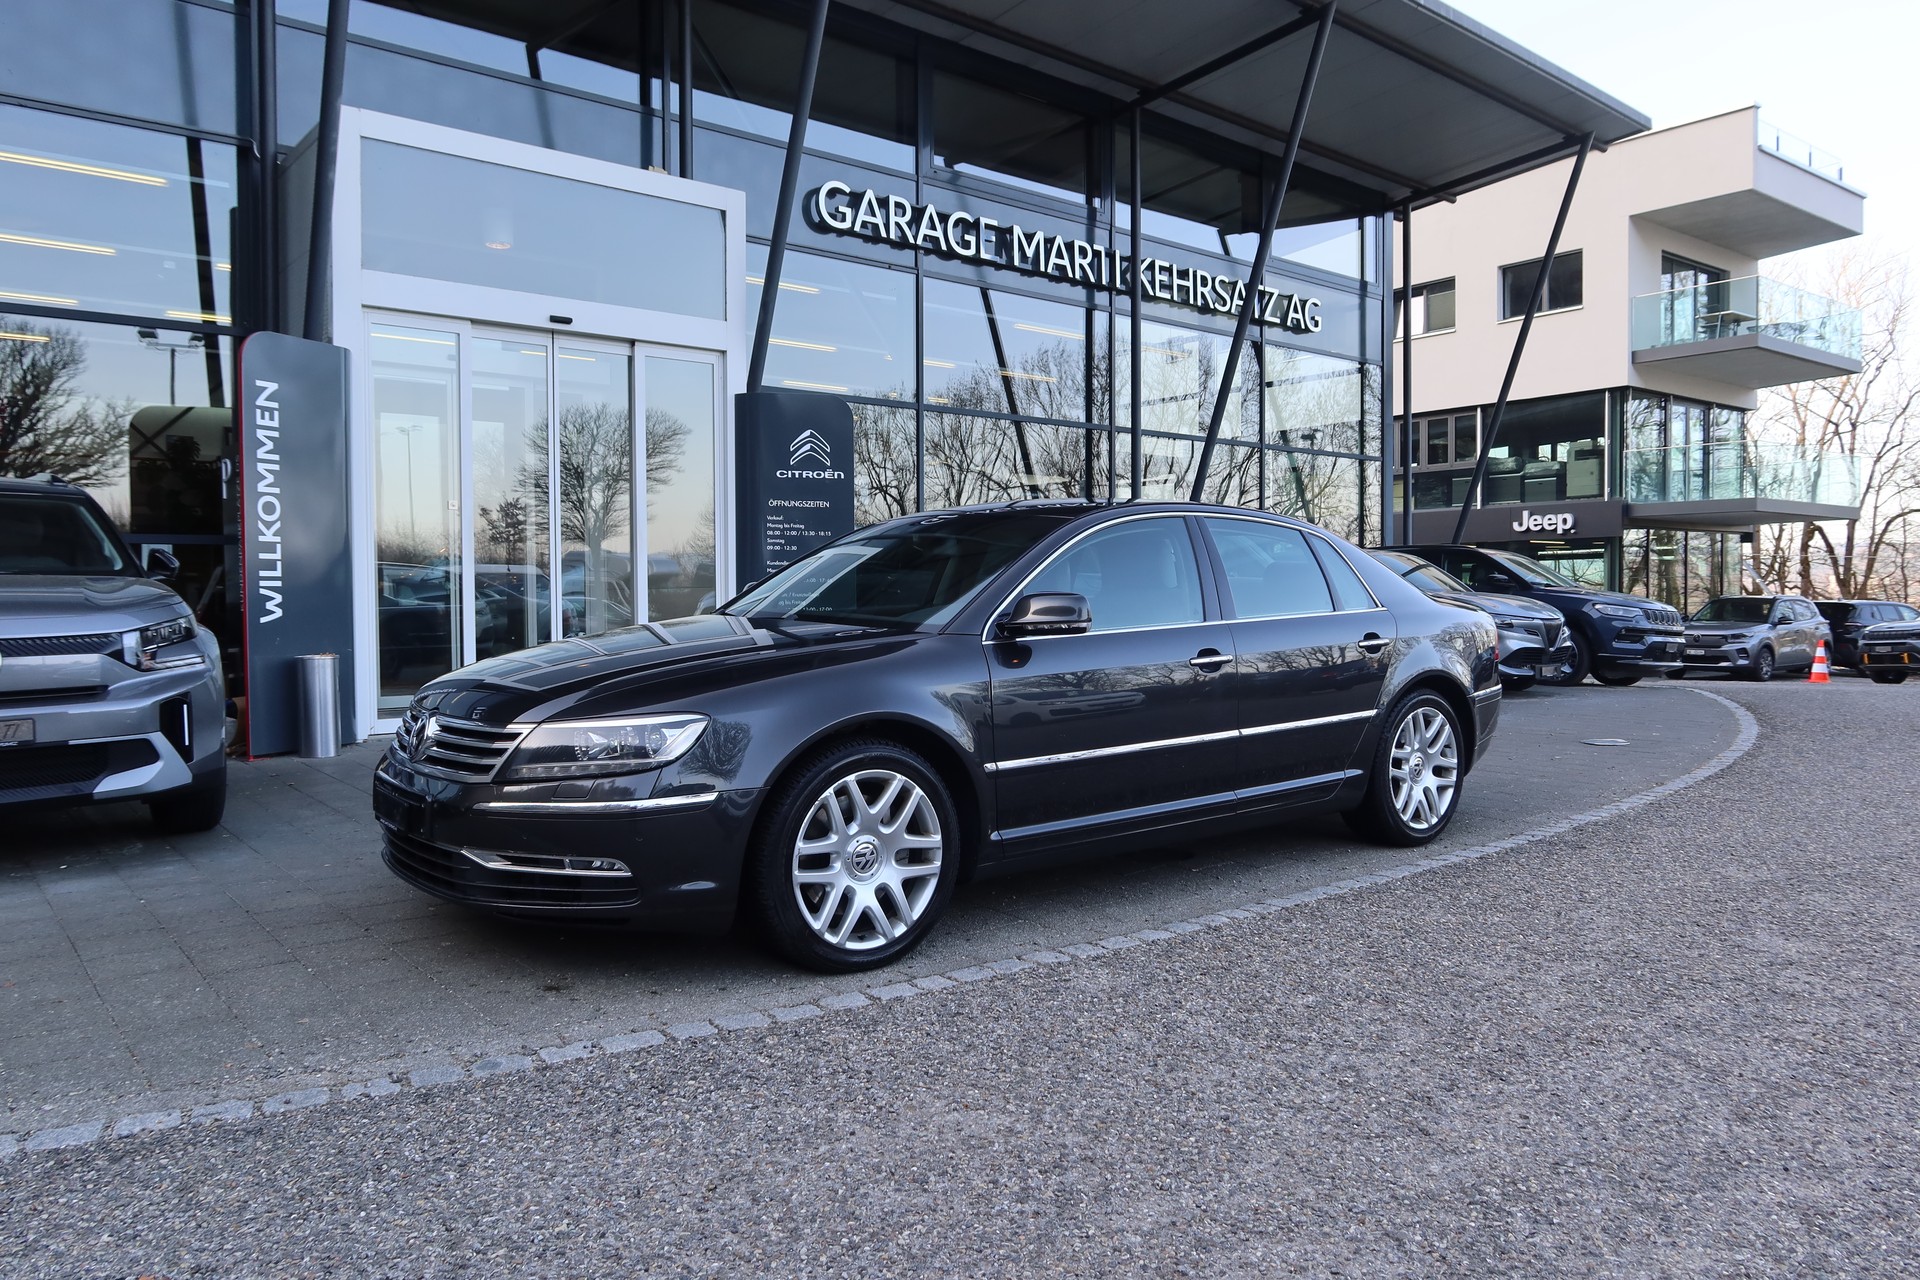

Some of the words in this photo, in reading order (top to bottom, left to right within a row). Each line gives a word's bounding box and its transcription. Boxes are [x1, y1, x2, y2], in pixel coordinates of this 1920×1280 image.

[818, 180, 1000, 262] GARAGE
[1012, 224, 1121, 288] MARTI
[1287, 293, 1323, 332] AG
[255, 379, 284, 624] WILLKOMMEN
[768, 498, 830, 508] ÖFFNUNGSZEITEN
[1512, 510, 1575, 534] Jeep
